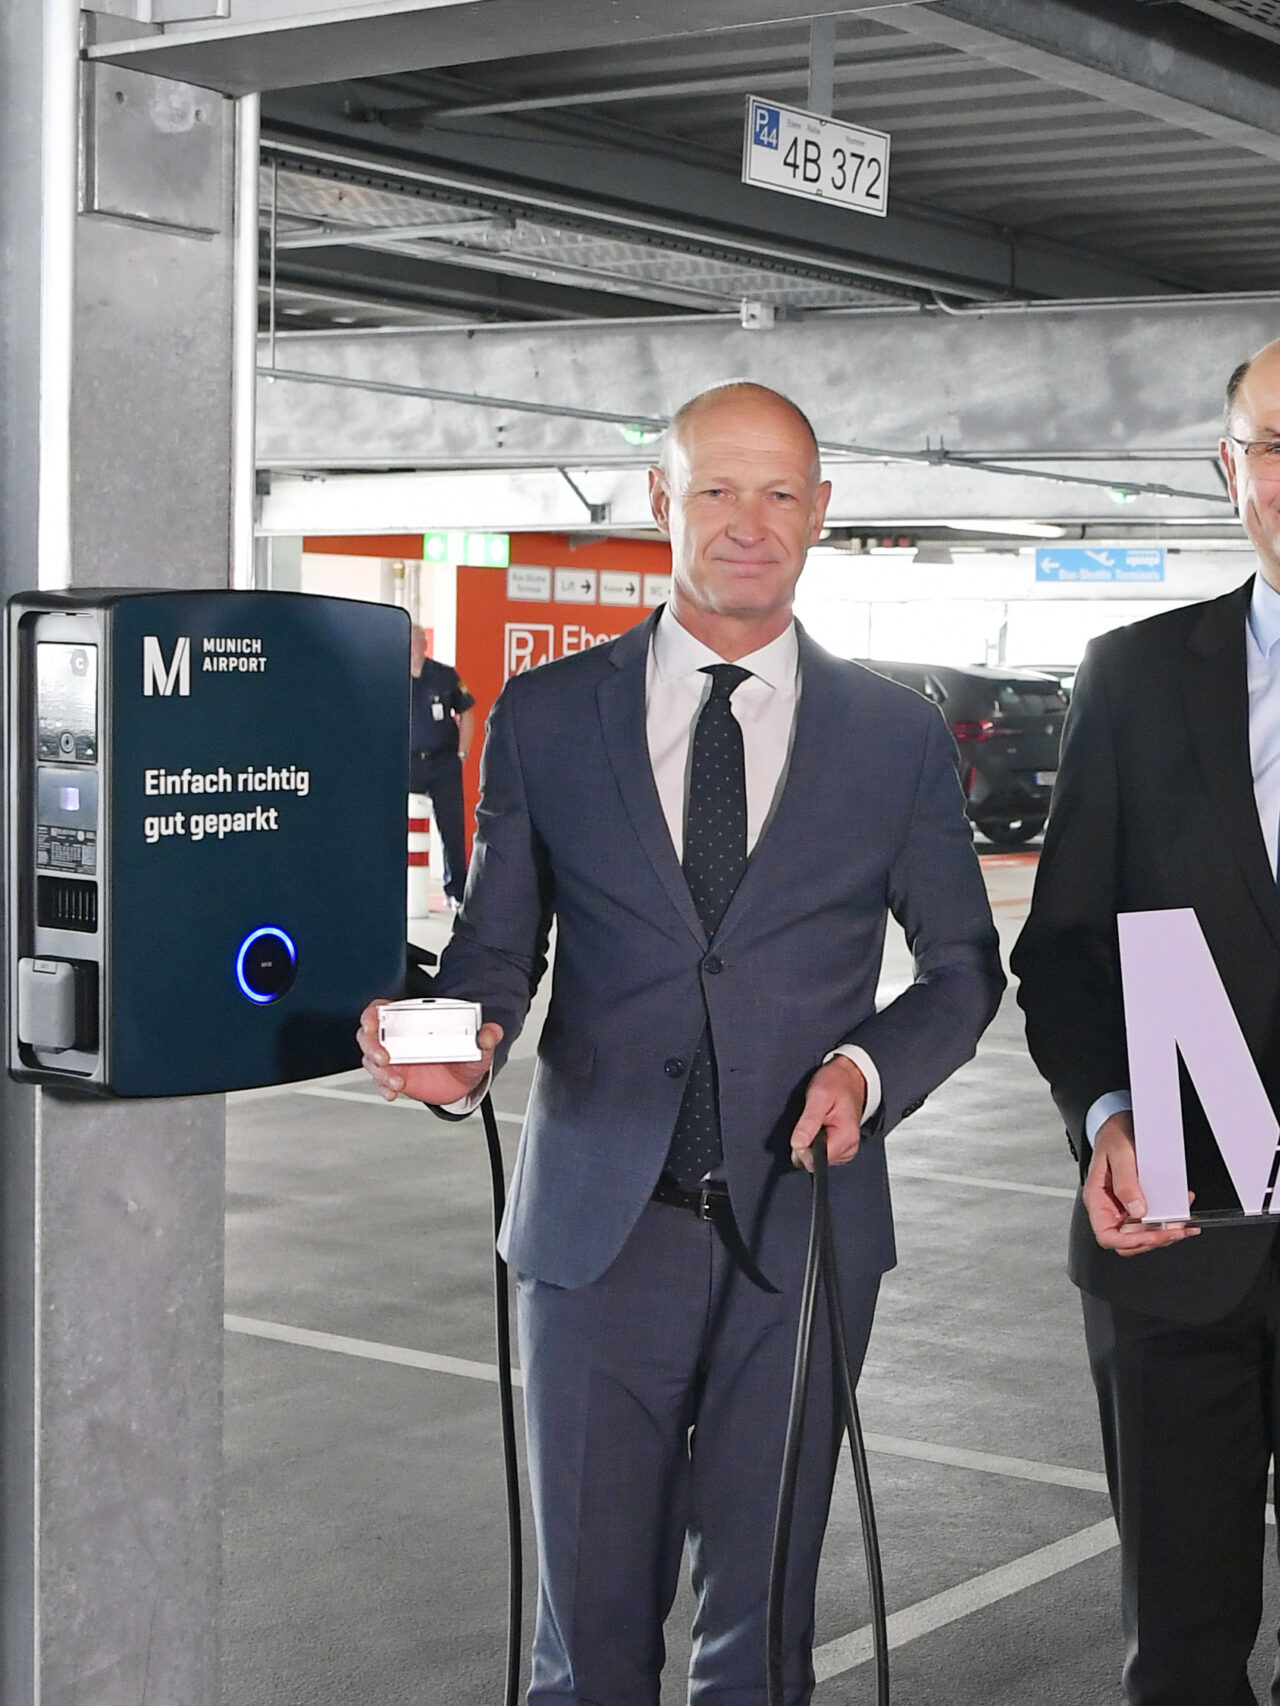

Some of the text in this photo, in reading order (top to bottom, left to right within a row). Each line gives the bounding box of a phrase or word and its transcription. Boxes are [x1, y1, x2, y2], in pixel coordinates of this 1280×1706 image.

[783, 136, 882, 200] 4B 372
[561, 580, 576, 592] Lift
[203, 638, 262, 654] MUNICH
[143, 636, 190, 696] M
[202, 657, 267, 673] AIRPORT
[144, 765, 310, 797] Einfach richtig
[144, 805, 279, 844] gut geparkt
